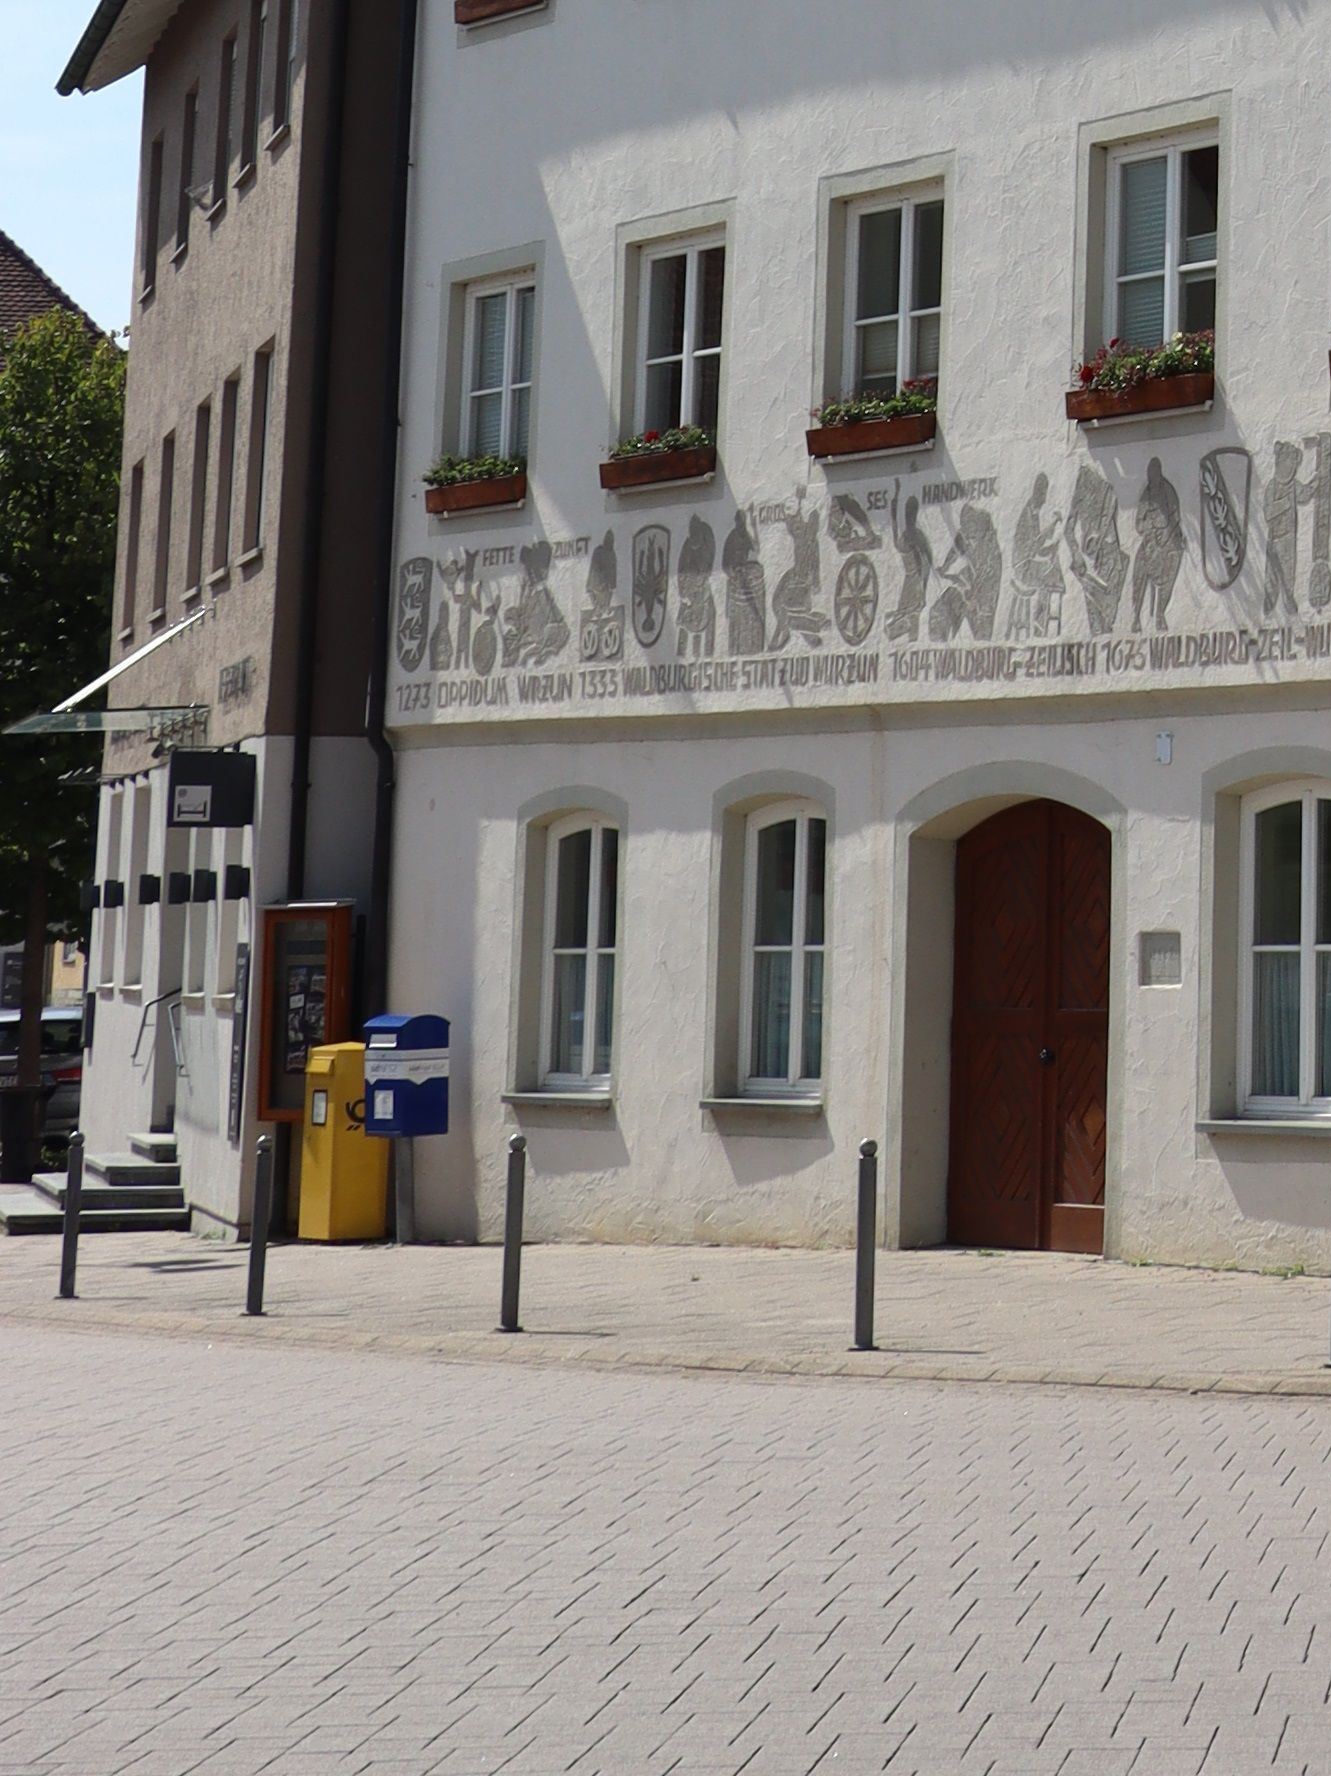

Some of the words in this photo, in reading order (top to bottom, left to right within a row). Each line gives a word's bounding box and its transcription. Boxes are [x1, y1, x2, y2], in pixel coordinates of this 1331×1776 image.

[867, 490, 887, 510] SES
[922, 476, 998, 505] HANDWERK
[482, 545, 516, 567] FETTE
[552, 537, 592, 559] ZUNFT
[396, 681, 432, 712] 1273
[437, 674, 510, 709] OPPIDUM
[578, 667, 618, 700] 1333
[887, 647, 931, 682] 1604
[1101, 636, 1148, 675] 1675
